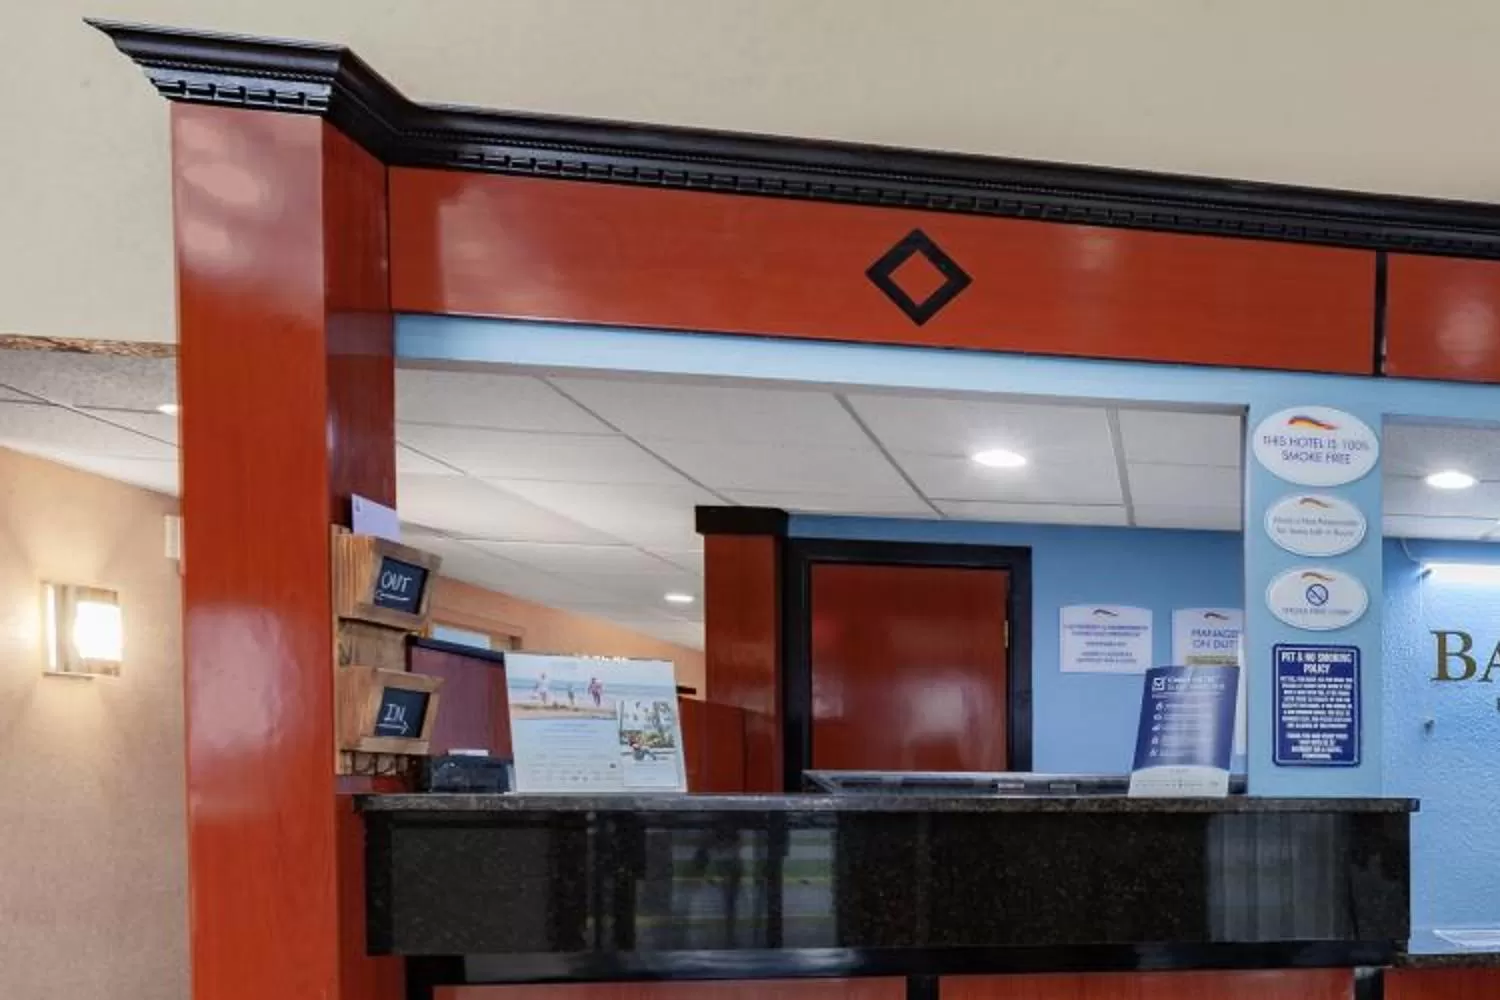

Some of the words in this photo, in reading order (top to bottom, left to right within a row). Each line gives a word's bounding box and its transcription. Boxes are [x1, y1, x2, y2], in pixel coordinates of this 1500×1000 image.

[1289, 436, 1325, 449] HOTEL
[1327, 438, 1337, 449] IS
[1281, 450, 1322, 462] SMOKE
[1326, 453, 1351, 465] FREE
[381, 570, 413, 593] OUT
[1303, 663, 1331, 674] POLICY
[383, 703, 406, 721] IN
